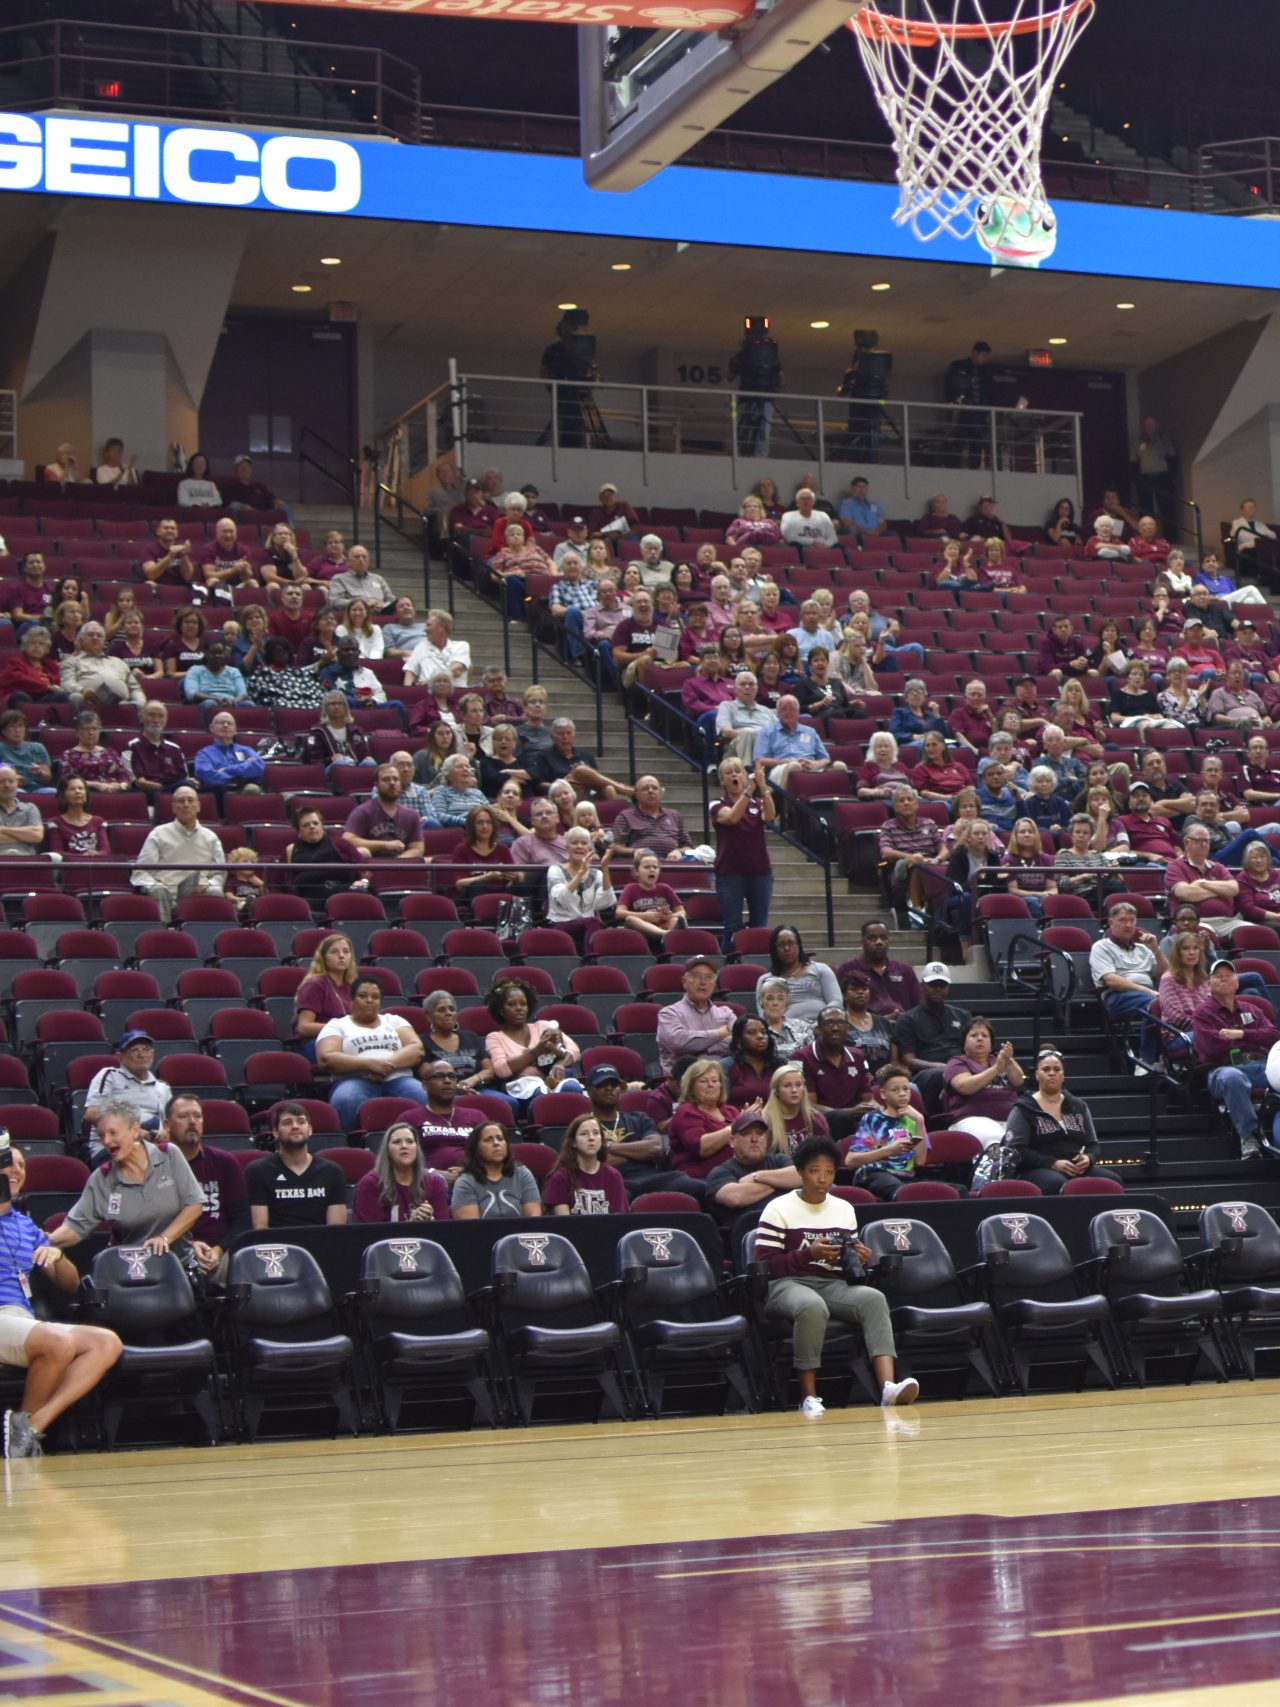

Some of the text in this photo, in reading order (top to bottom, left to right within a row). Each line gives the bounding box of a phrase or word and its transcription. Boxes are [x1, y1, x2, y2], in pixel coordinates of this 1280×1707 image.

[676, 364, 722, 384] 105
[351, 1034, 379, 1047] TEXAS
[275, 1187, 326, 1199] TEXAS A&M
